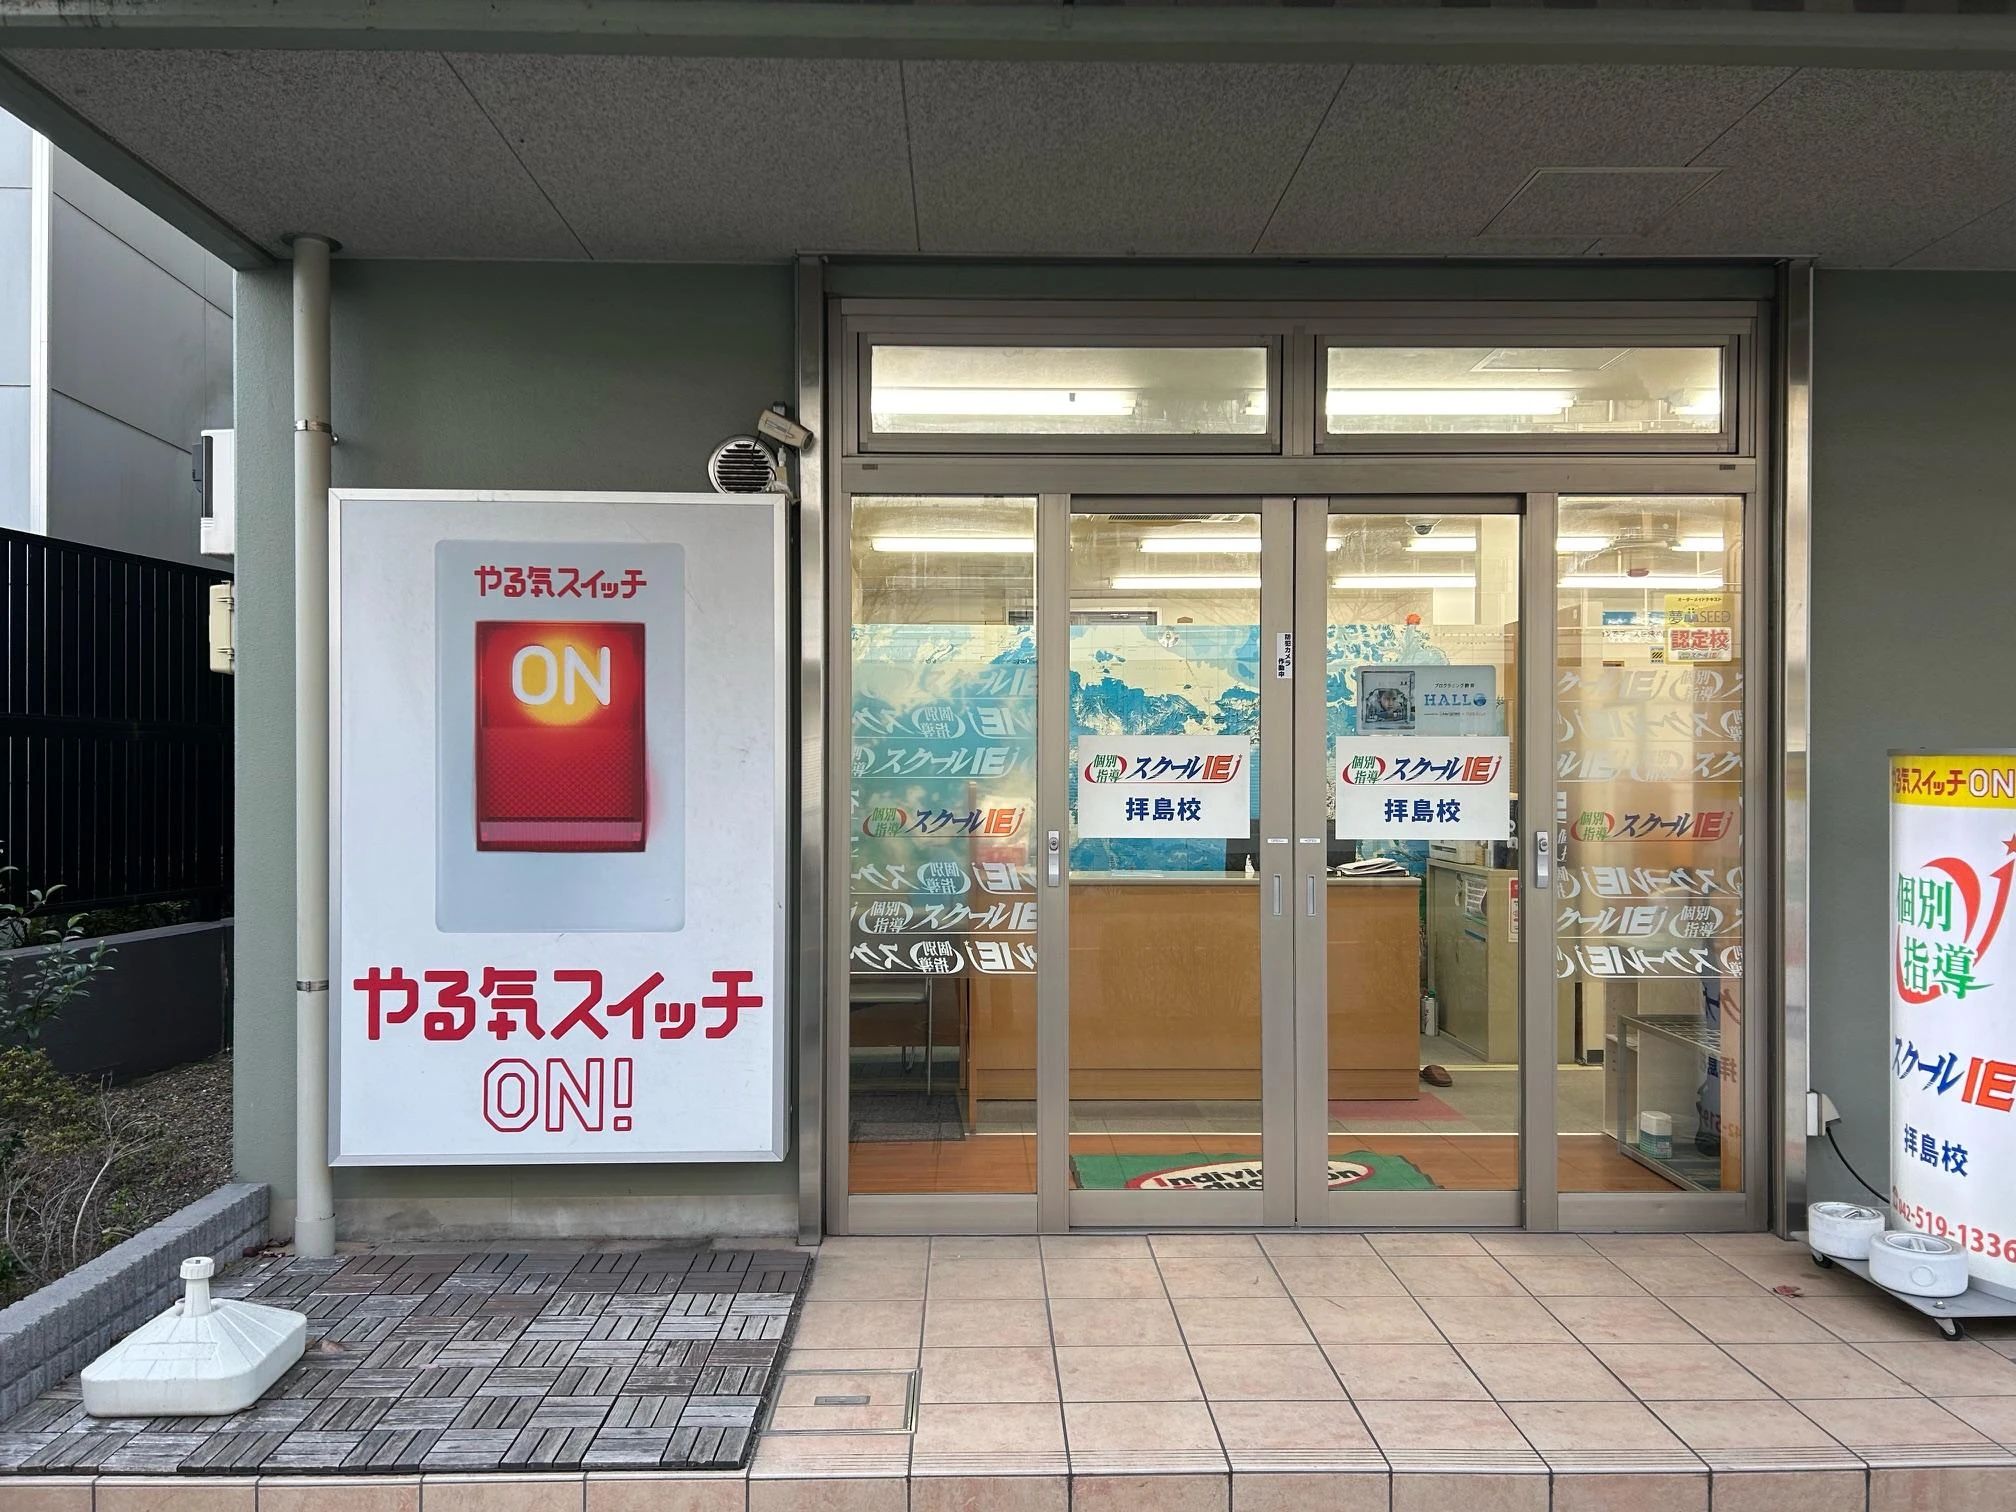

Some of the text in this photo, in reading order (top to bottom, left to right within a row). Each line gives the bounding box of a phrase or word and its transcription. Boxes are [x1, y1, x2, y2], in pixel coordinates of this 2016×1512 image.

[474, 565, 647, 599] やる気スイッチ
[1284, 633, 1292, 667] 防犯カメラ
[1671, 629, 1729, 650] 認定校
[512, 644, 611, 706] ON
[1094, 754, 1117, 768] 個別
[1125, 754, 1233, 782] スクールIE
[1351, 755, 1376, 769] 個別
[1384, 755, 1491, 782] スクールIE
[1096, 768, 1121, 784] 指導
[1353, 769, 1380, 784] 指導
[872, 807, 897, 821] 個別
[1126, 797, 1202, 822] 拝島校
[1384, 798, 1461, 823] 拝島校
[1580, 811, 1605, 826] 個別
[874, 822, 901, 837] 指導
[1583, 827, 1609, 841] 指導
[1613, 812, 1724, 838] スクールIE
[870, 902, 900, 917] 個別
[1680, 905, 1711, 921] 個別
[1898, 872, 1953, 931] 個別
[873, 918, 905, 934] 指導
[1684, 922, 1716, 937] 指導
[1904, 936, 1995, 999] 指導
[353, 966, 763, 1041] やる気スイッチ
[484, 1057, 633, 1133] ON!
[1904, 1123, 1968, 1177] 拝島校
